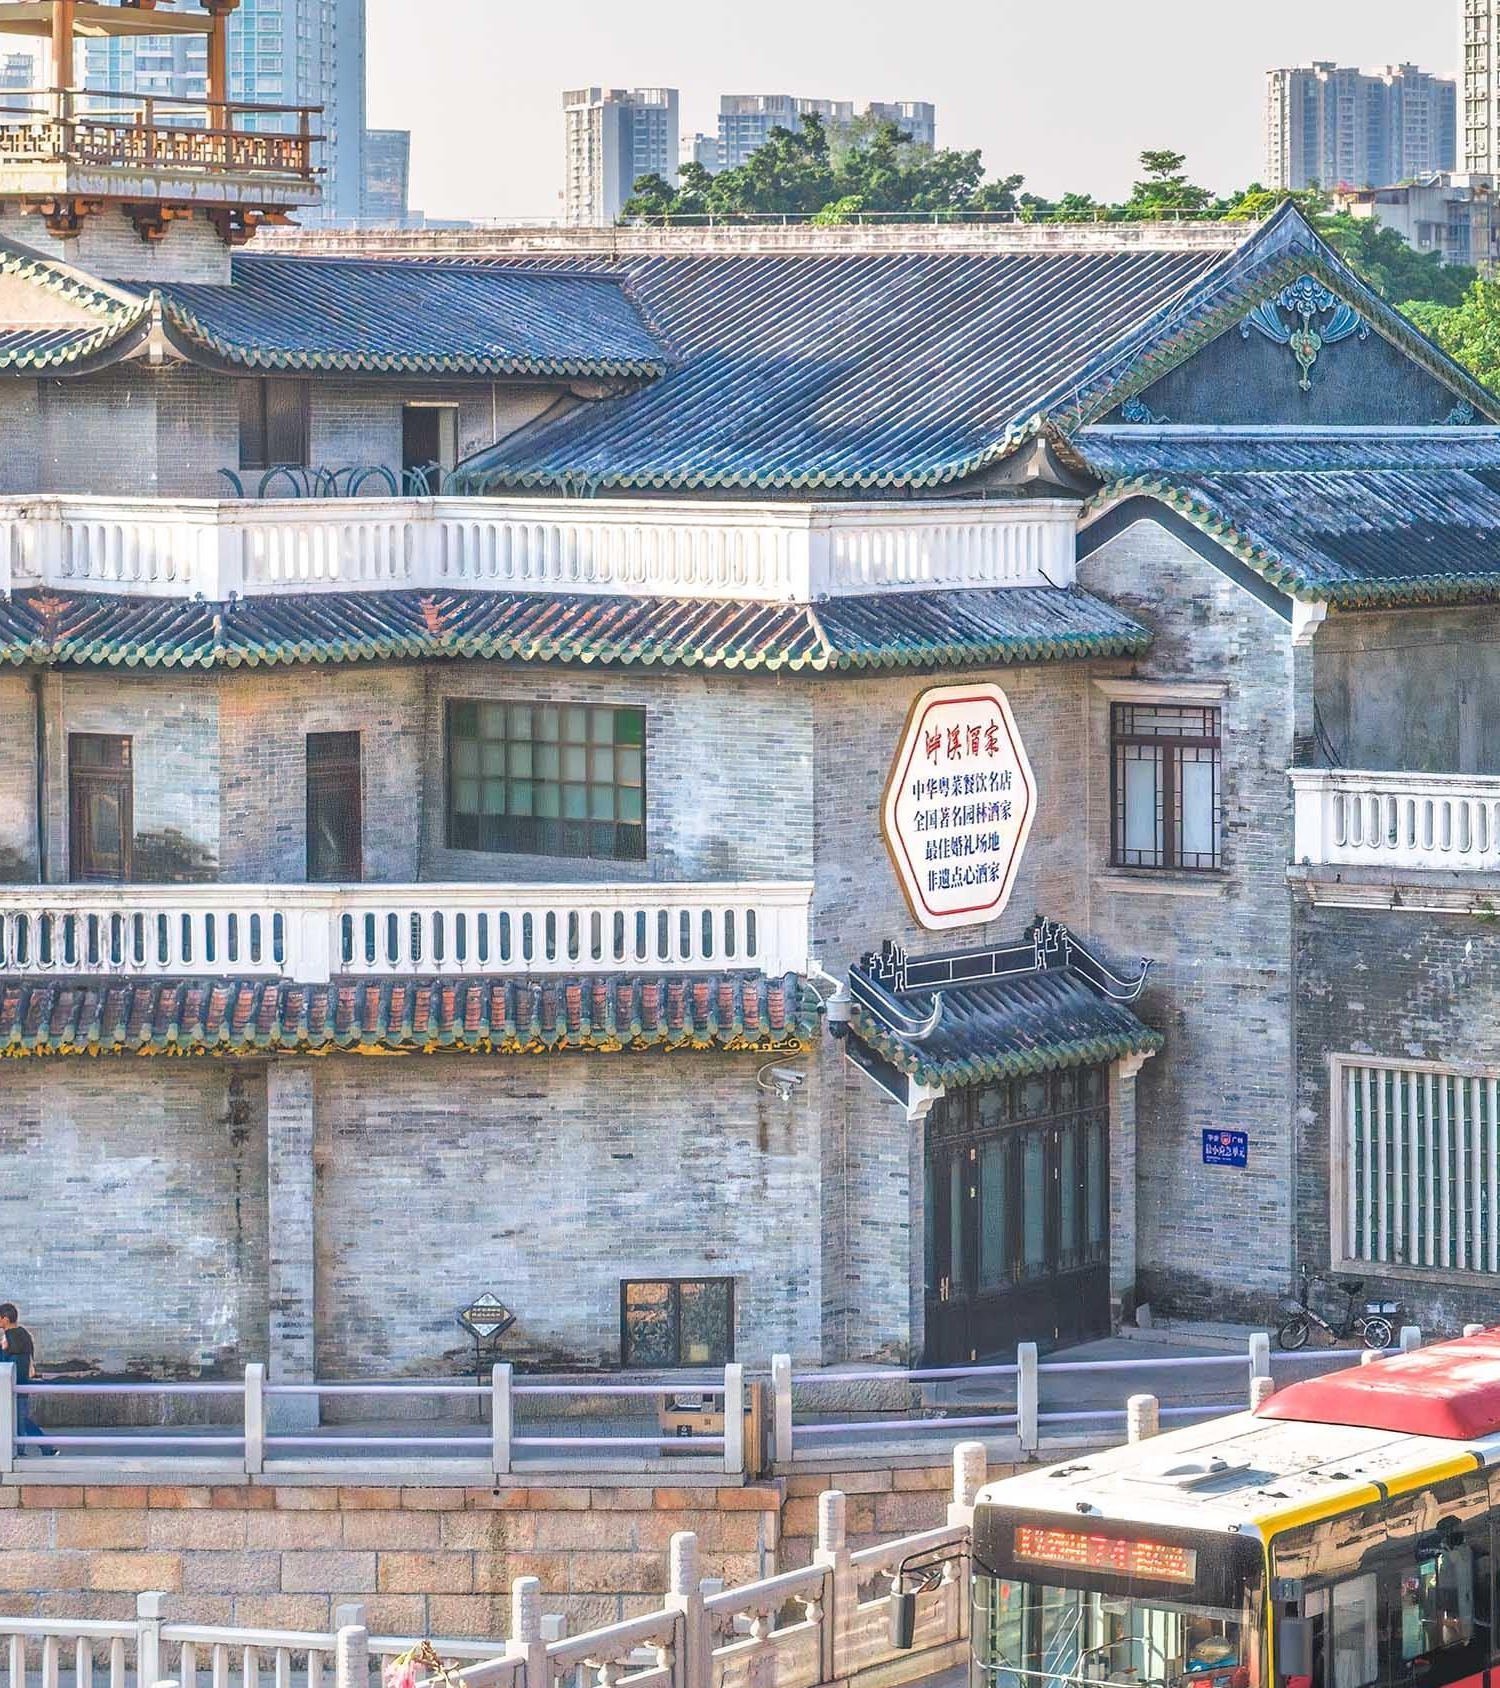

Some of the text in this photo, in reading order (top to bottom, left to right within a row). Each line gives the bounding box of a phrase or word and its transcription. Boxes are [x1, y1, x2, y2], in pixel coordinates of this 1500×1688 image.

[912, 770, 1012, 801] 中华粤菜餐饮名店
[913, 800, 1012, 832] 全国著名园林酒家
[925, 831, 1000, 861] 最佳婚礼场地
[928, 861, 1000, 892] 非遗点心酒家
